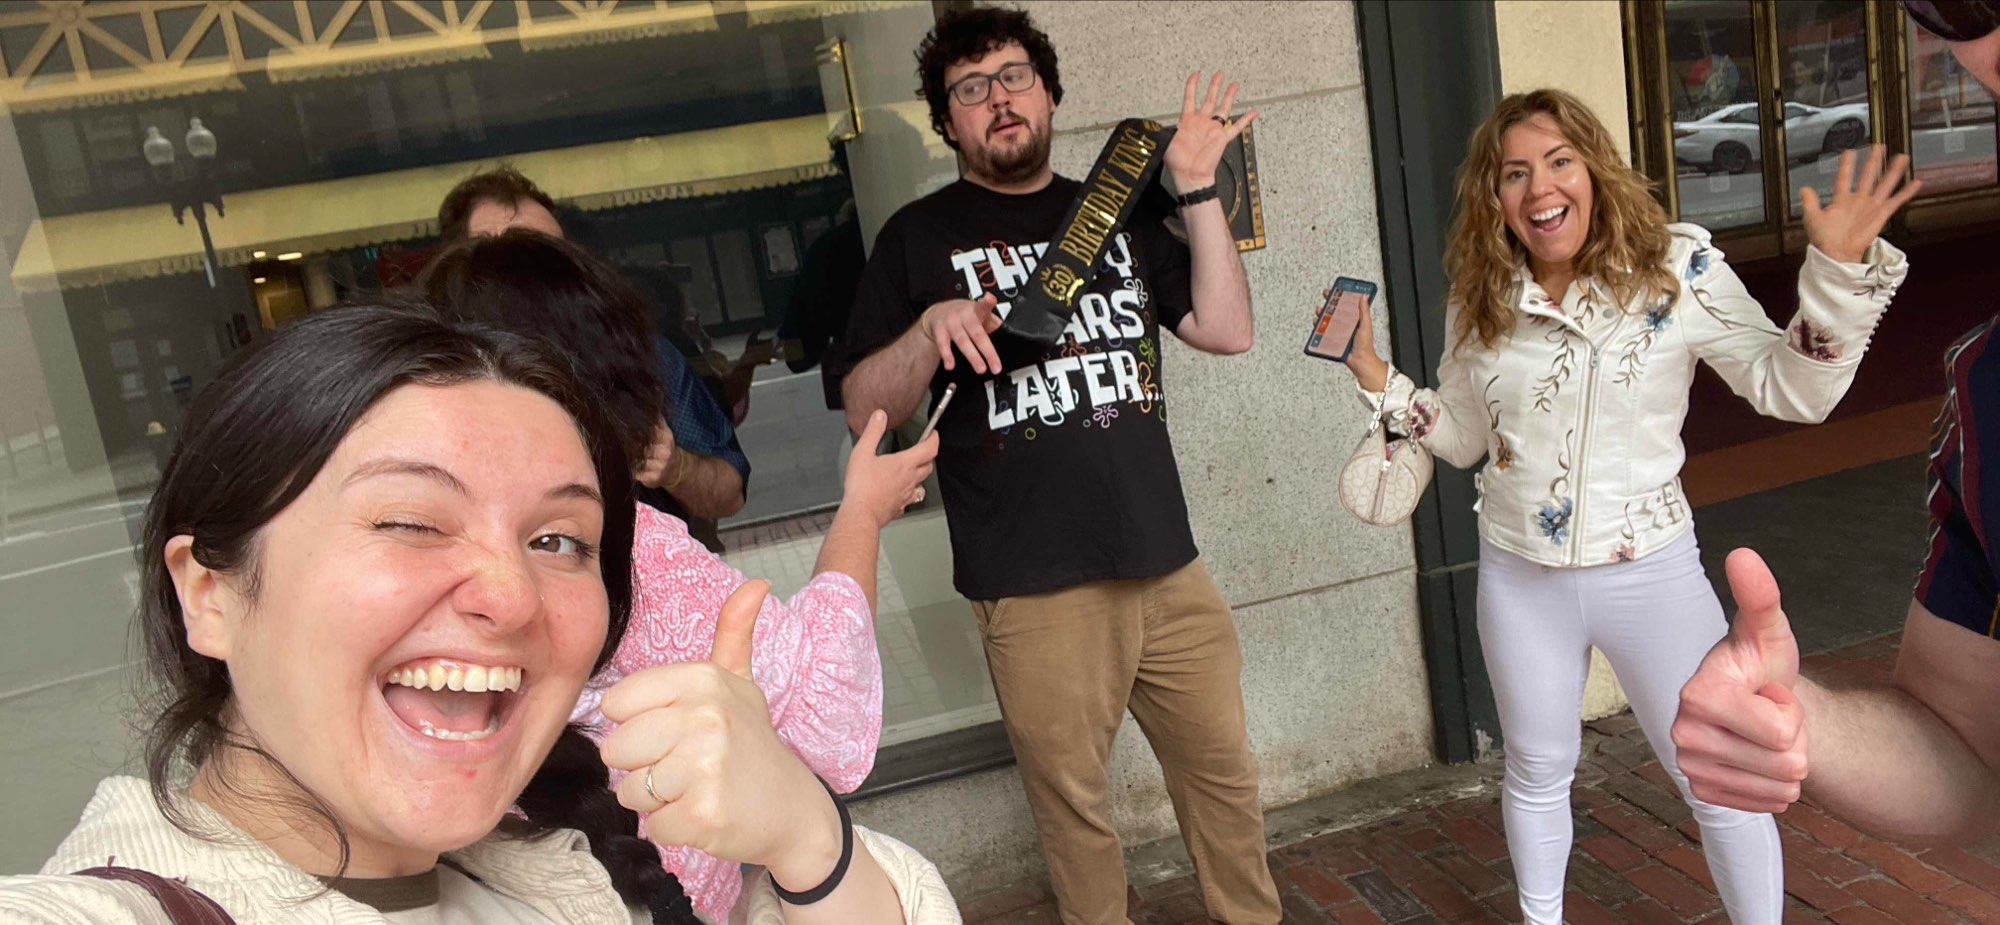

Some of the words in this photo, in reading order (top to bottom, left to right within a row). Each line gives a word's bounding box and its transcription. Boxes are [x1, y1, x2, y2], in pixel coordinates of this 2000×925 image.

[1108, 127, 1156, 180] KING
[1059, 169, 1132, 266] BIRTHDAY
[1049, 271, 1071, 294] 30
